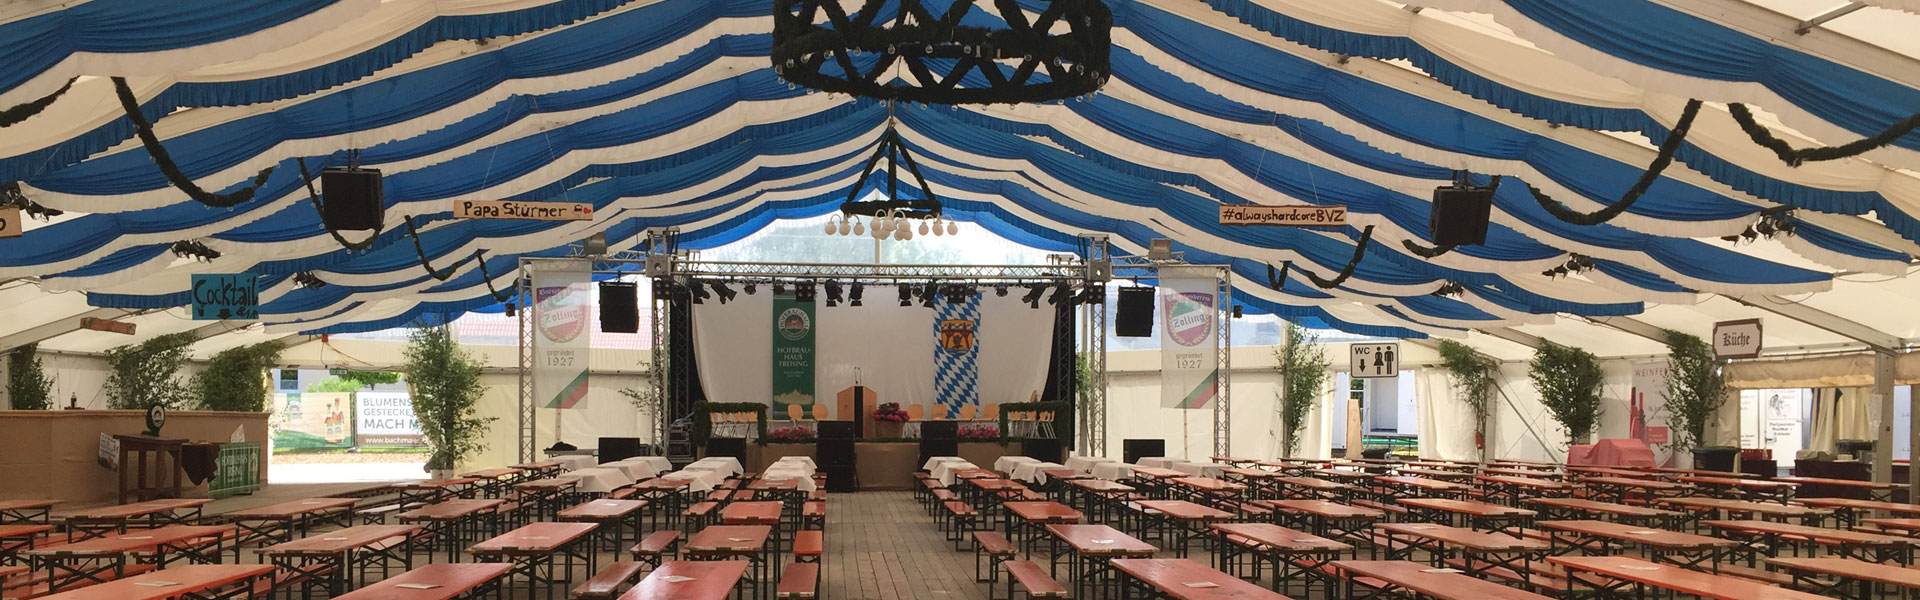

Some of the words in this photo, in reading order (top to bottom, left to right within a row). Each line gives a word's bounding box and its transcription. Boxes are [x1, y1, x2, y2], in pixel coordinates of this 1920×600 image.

[463, 201, 499, 217] Papa
[502, 202, 567, 217] Stürmer
[1222, 208, 1344, 222] #alwayshardcoreBVZ
[193, 276, 258, 306] Cocktail
[544, 310, 578, 323] Zolling
[1173, 314, 1205, 328] Zolling
[1723, 332, 1750, 347] Küche
[1354, 347, 1370, 355] WC
[547, 357, 574, 367] 1927
[779, 360, 808, 368] FREISING
[1177, 360, 1203, 369] 1927
[364, 418, 404, 429] MACH
